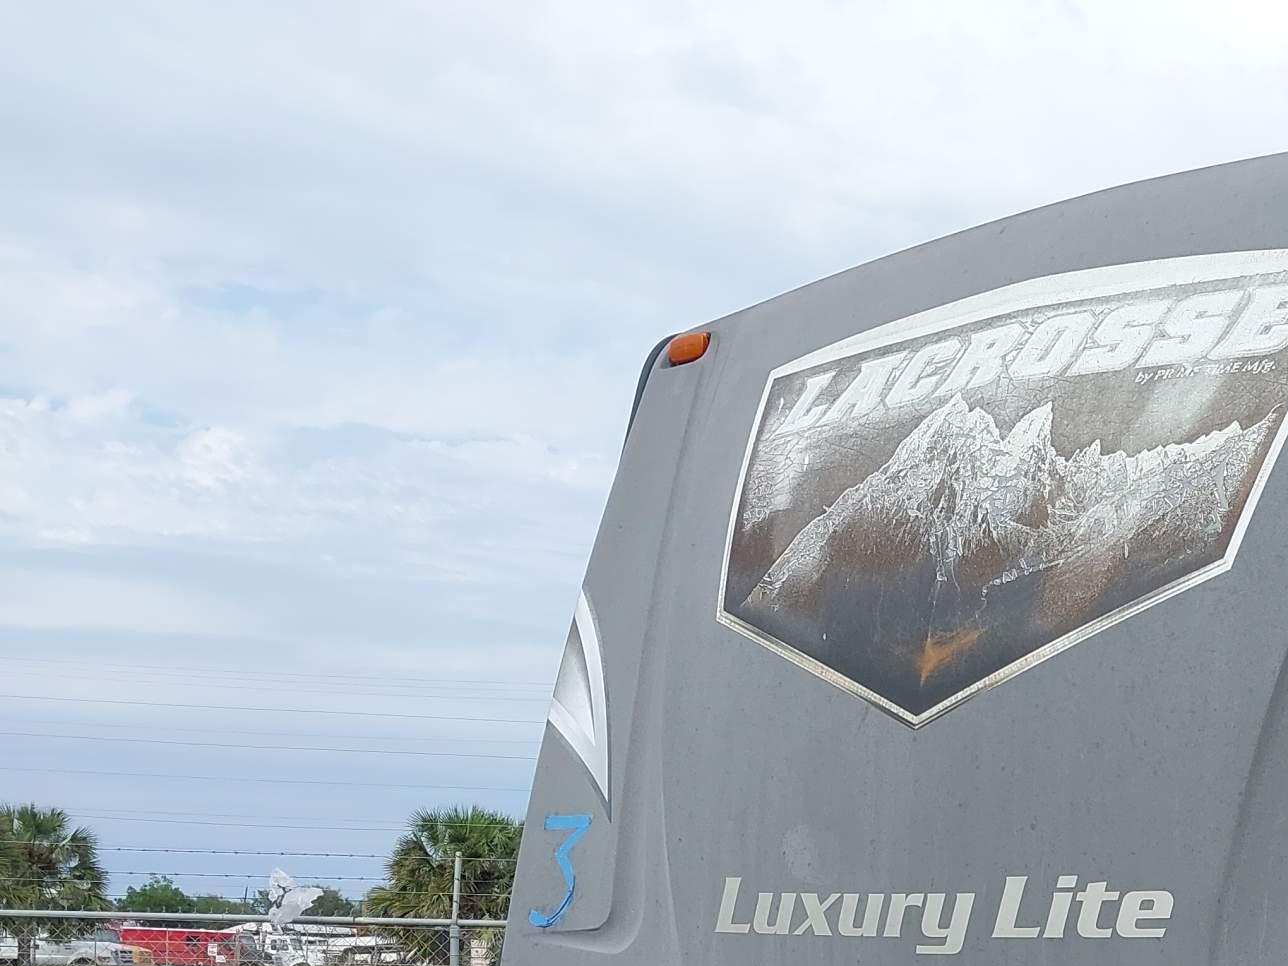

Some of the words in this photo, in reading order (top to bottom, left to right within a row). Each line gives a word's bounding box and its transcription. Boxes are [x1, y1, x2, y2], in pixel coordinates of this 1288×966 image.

[1134, 371, 1154, 385] by
[529, 814, 593, 929] 3
[713, 876, 975, 955] Luxury
[991, 875, 1174, 938] Lite
